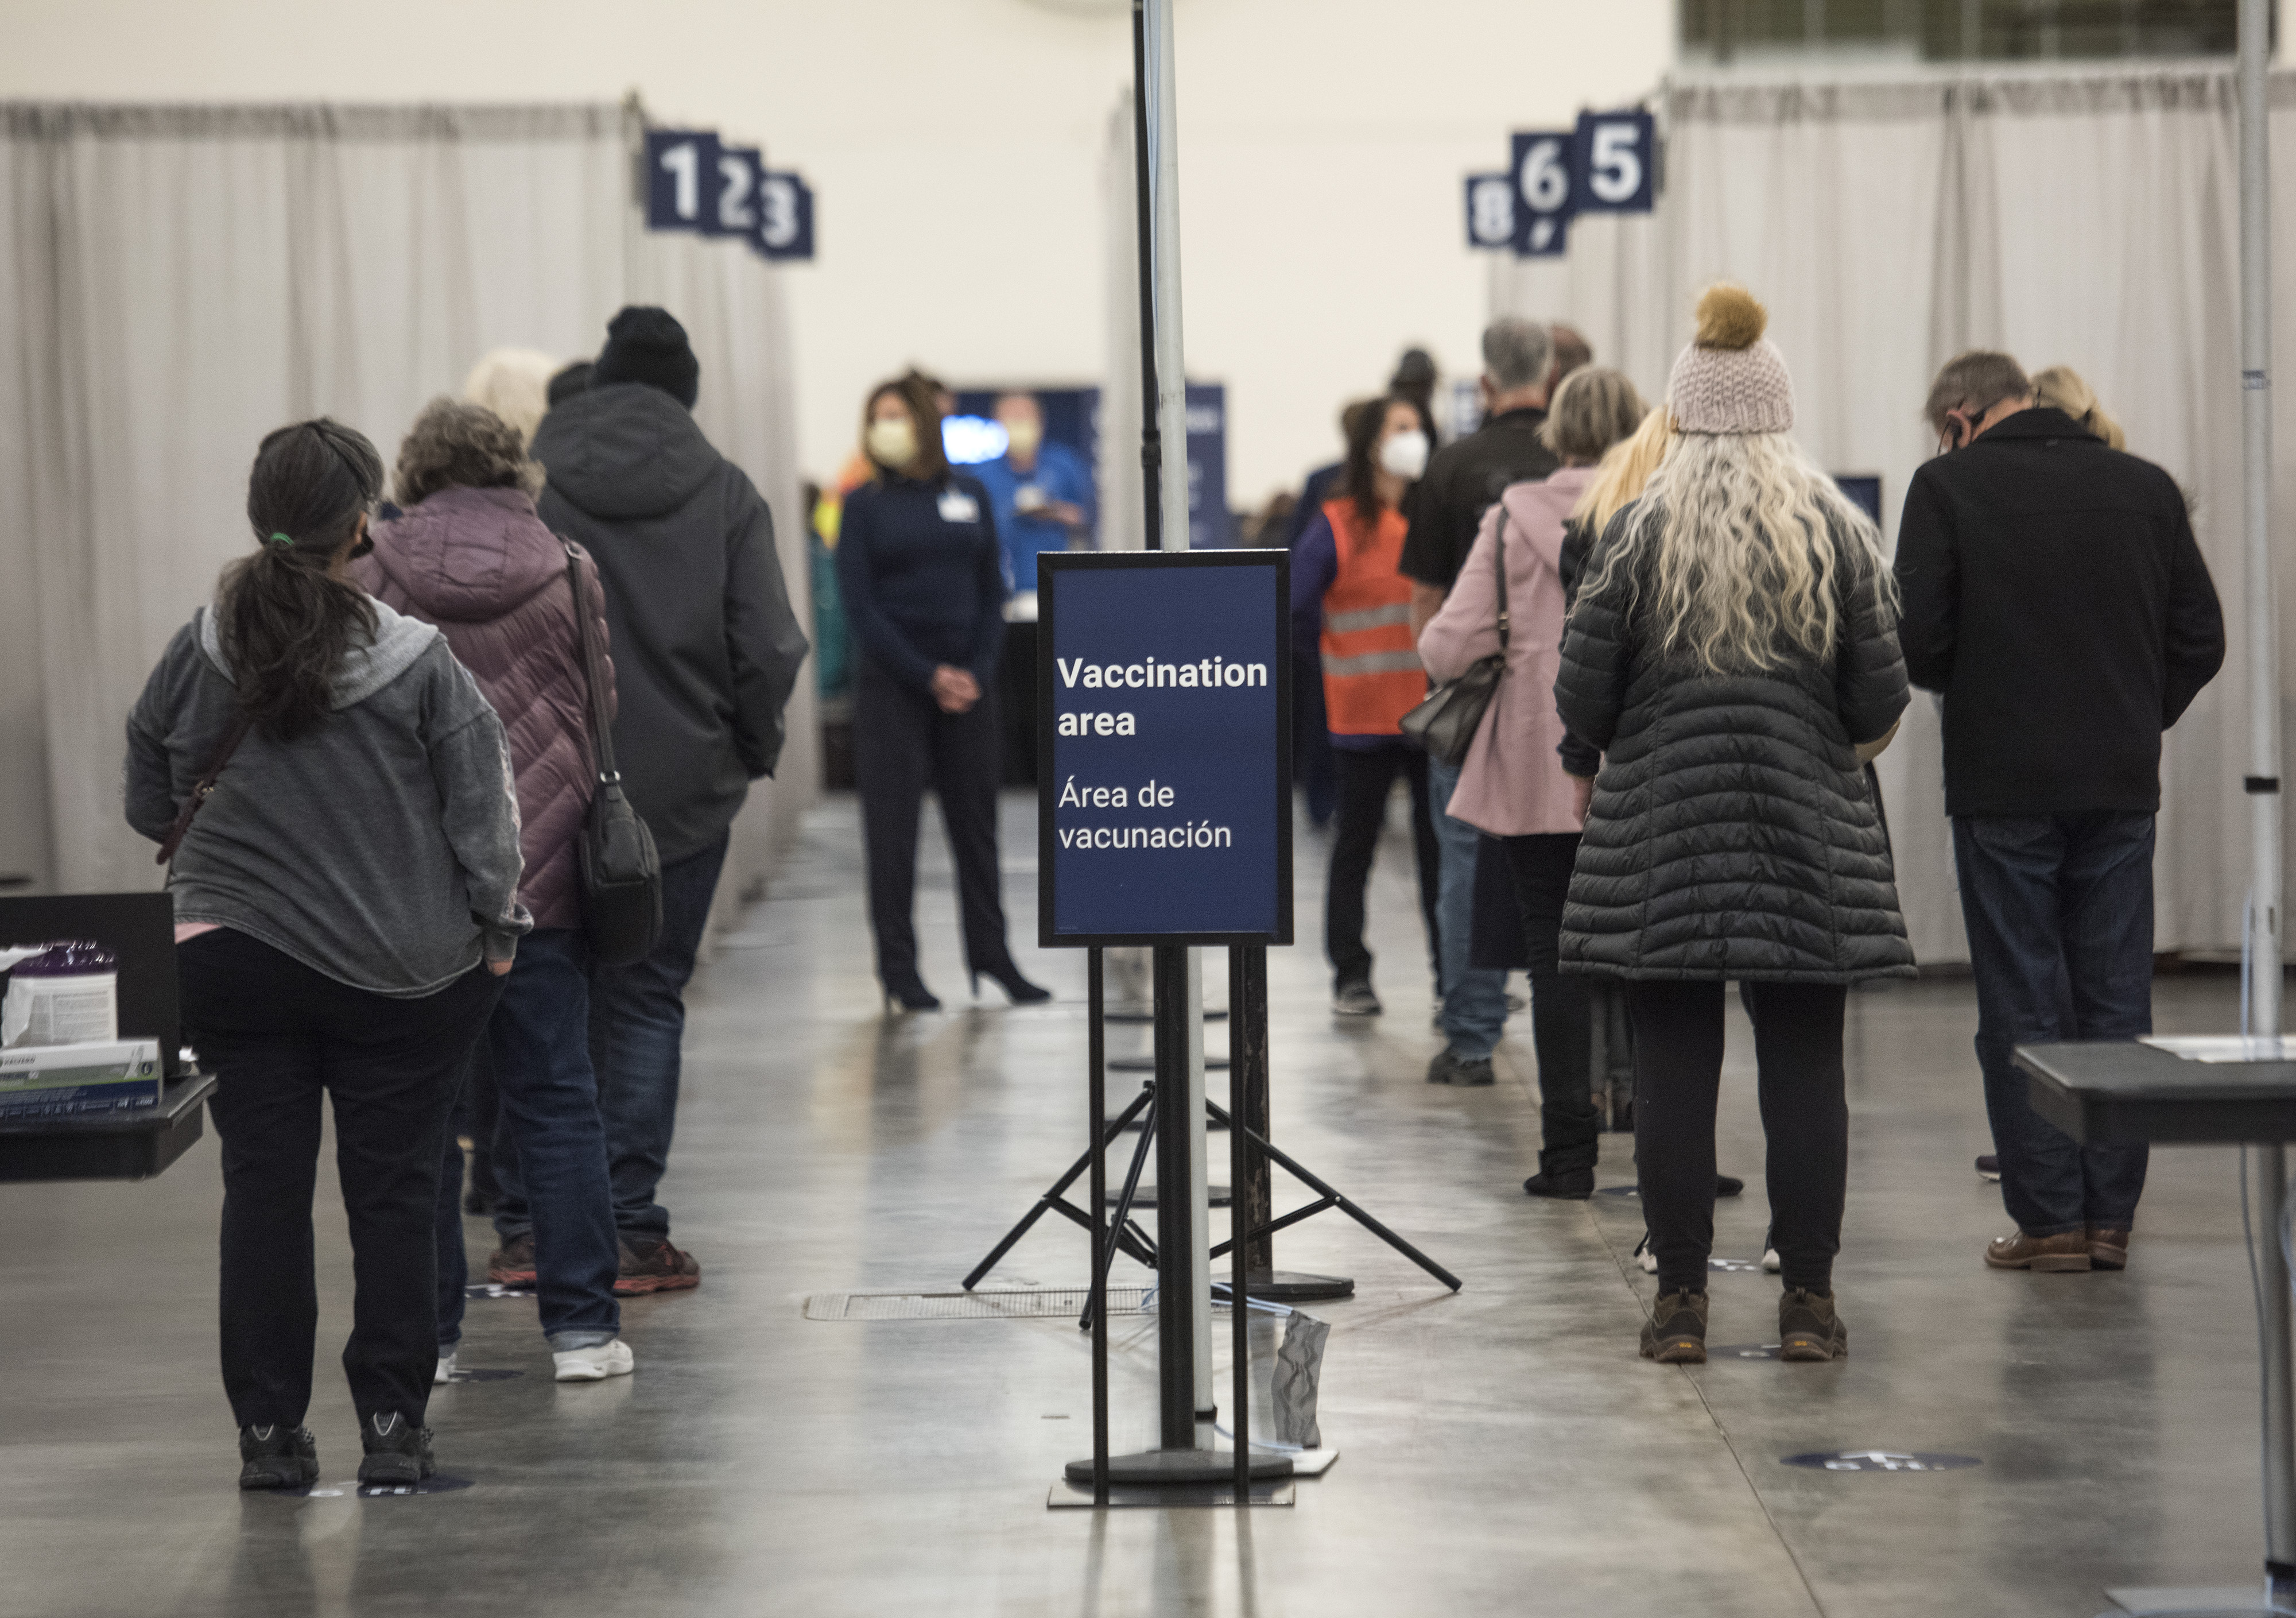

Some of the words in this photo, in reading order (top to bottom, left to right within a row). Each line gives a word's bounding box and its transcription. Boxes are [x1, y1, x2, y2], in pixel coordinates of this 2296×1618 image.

[660, 142, 699, 219] 1
[718, 155, 757, 228] 2
[1520, 140, 1569, 212] 6
[1588, 122, 1641, 203] 5
[759, 179, 801, 248] 3
[1057, 656, 1267, 688] Vaccination
[1058, 712, 1135, 736] area
[1058, 775, 1127, 808] Área
[1138, 780, 1174, 807] de
[1059, 820, 1231, 849] vacunación
